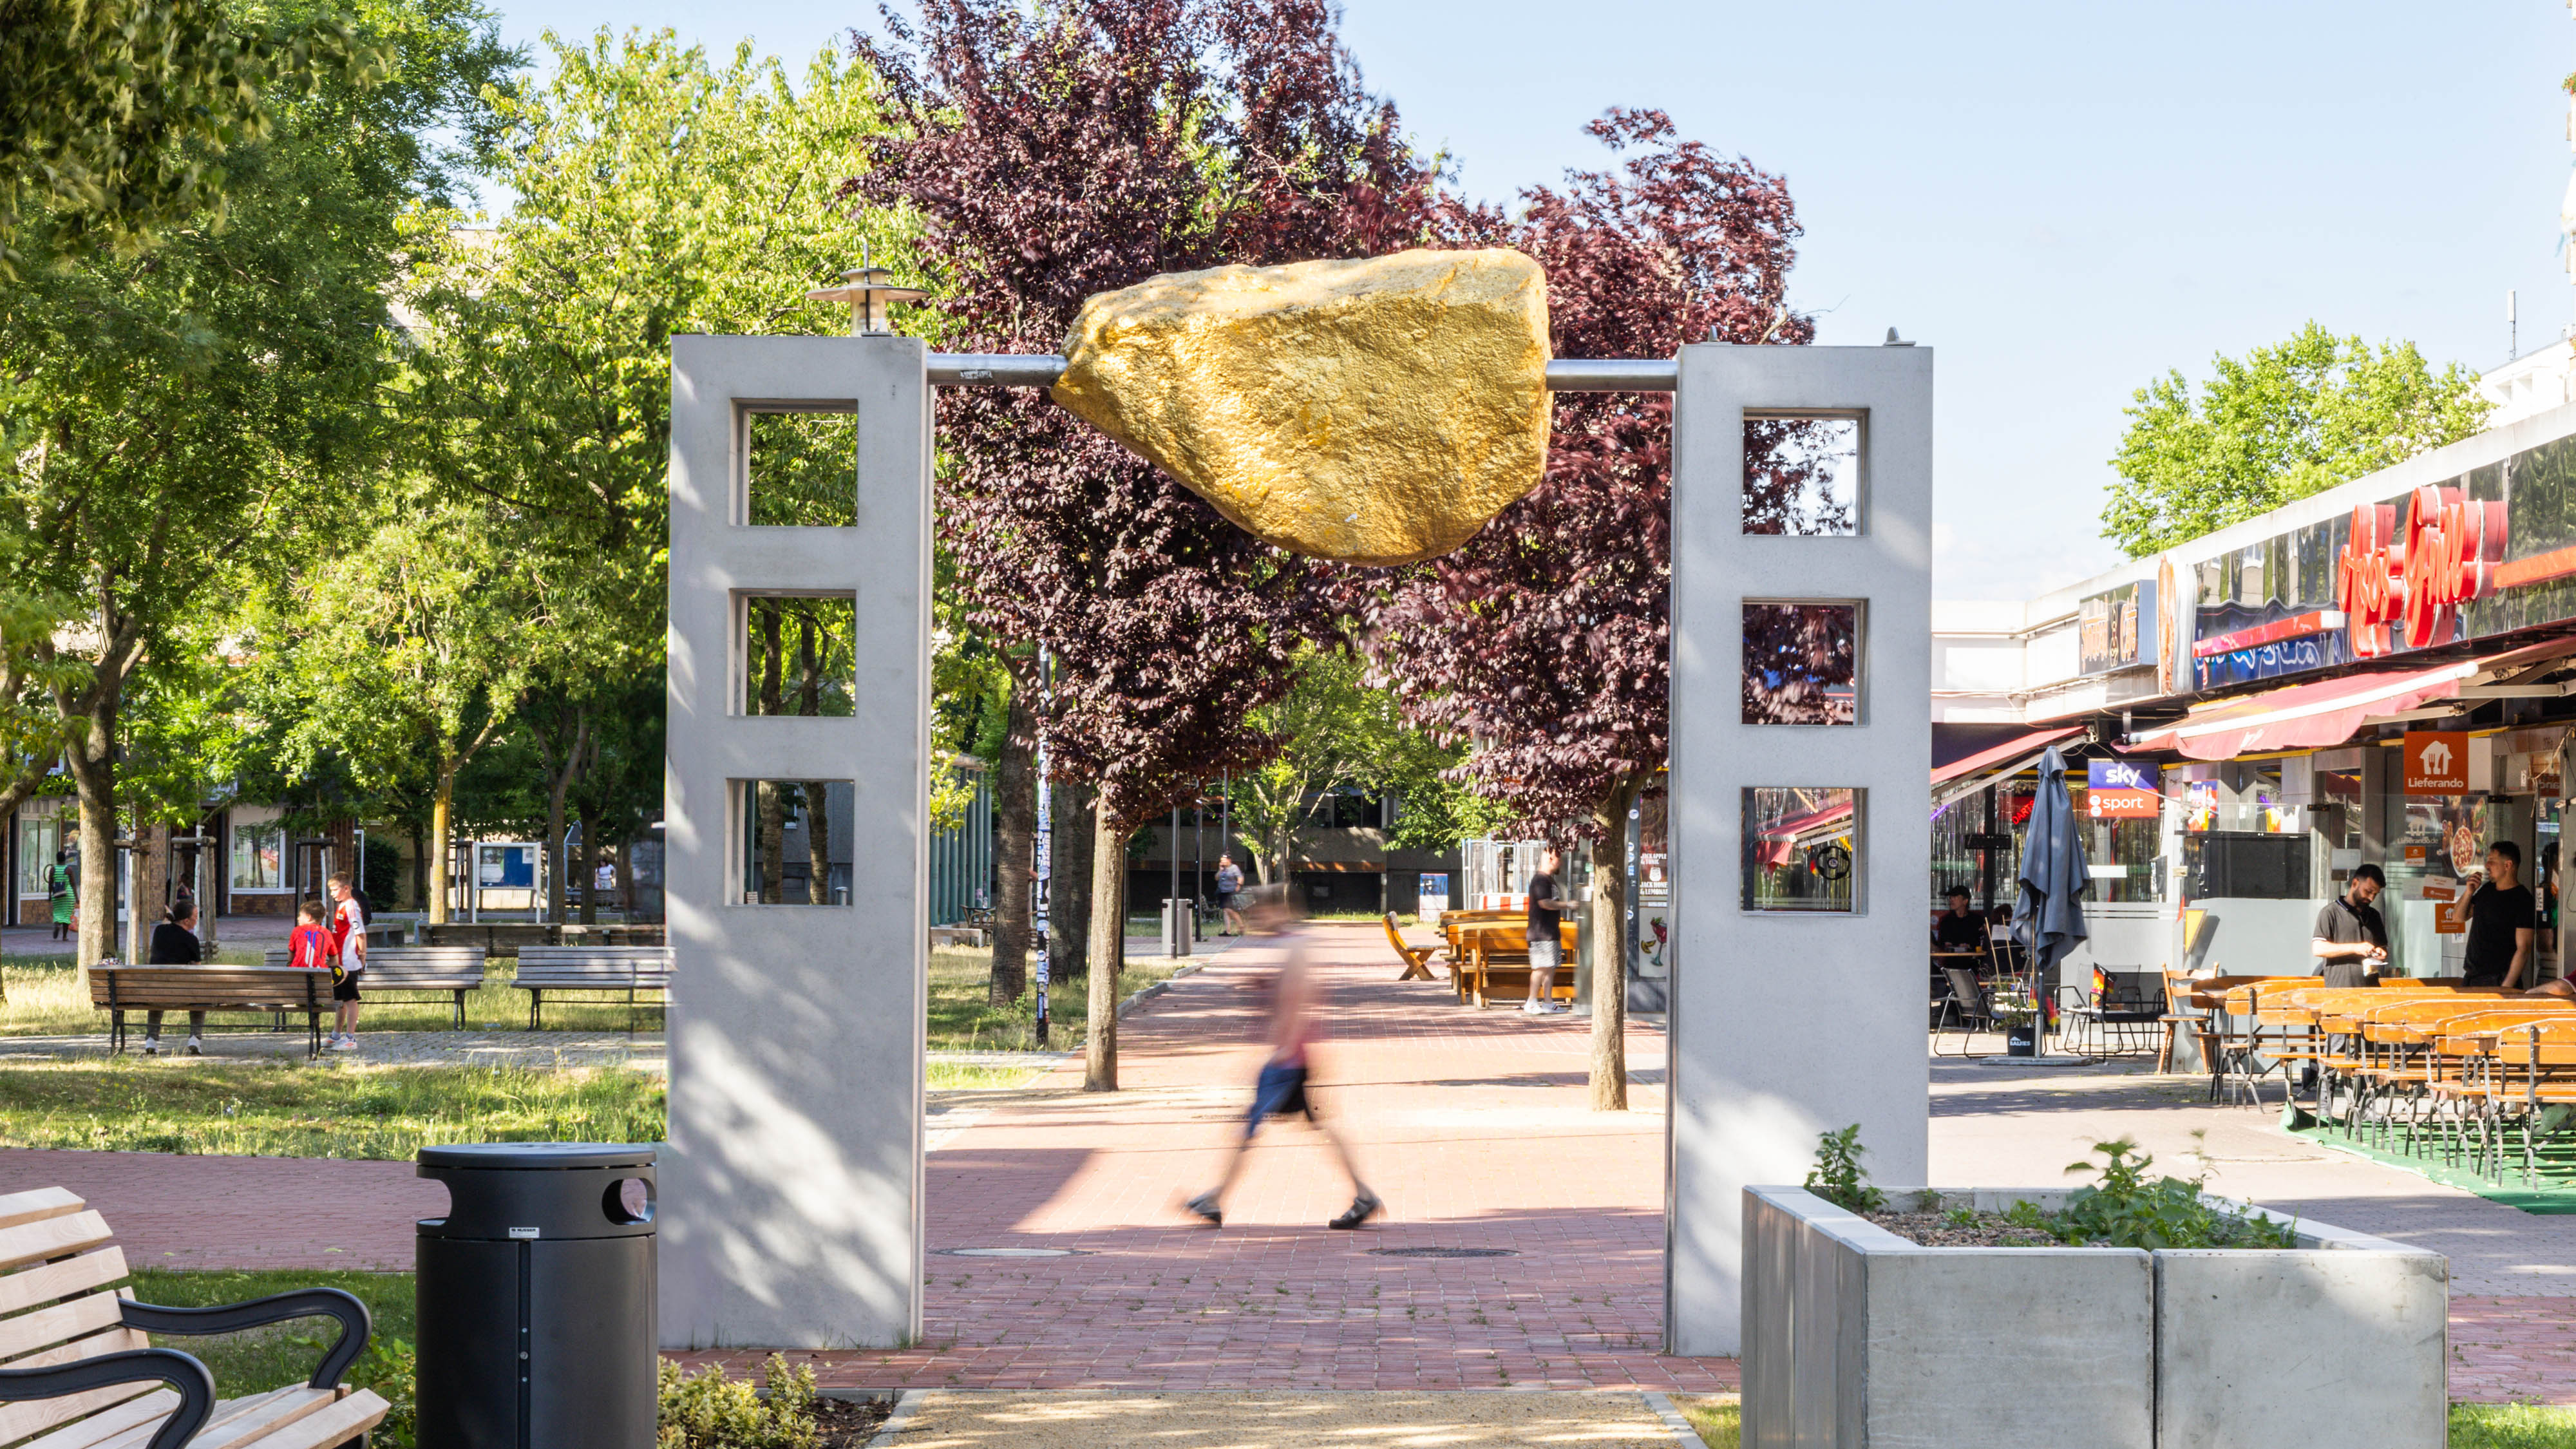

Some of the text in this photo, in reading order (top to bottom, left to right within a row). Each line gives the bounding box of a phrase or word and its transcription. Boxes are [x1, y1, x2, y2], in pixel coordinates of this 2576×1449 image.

[2105, 765, 2141, 786] sky
[2408, 777, 2464, 788] Lieferando
[2103, 797, 2144, 811] sport
[305, 930, 325, 968] 10
